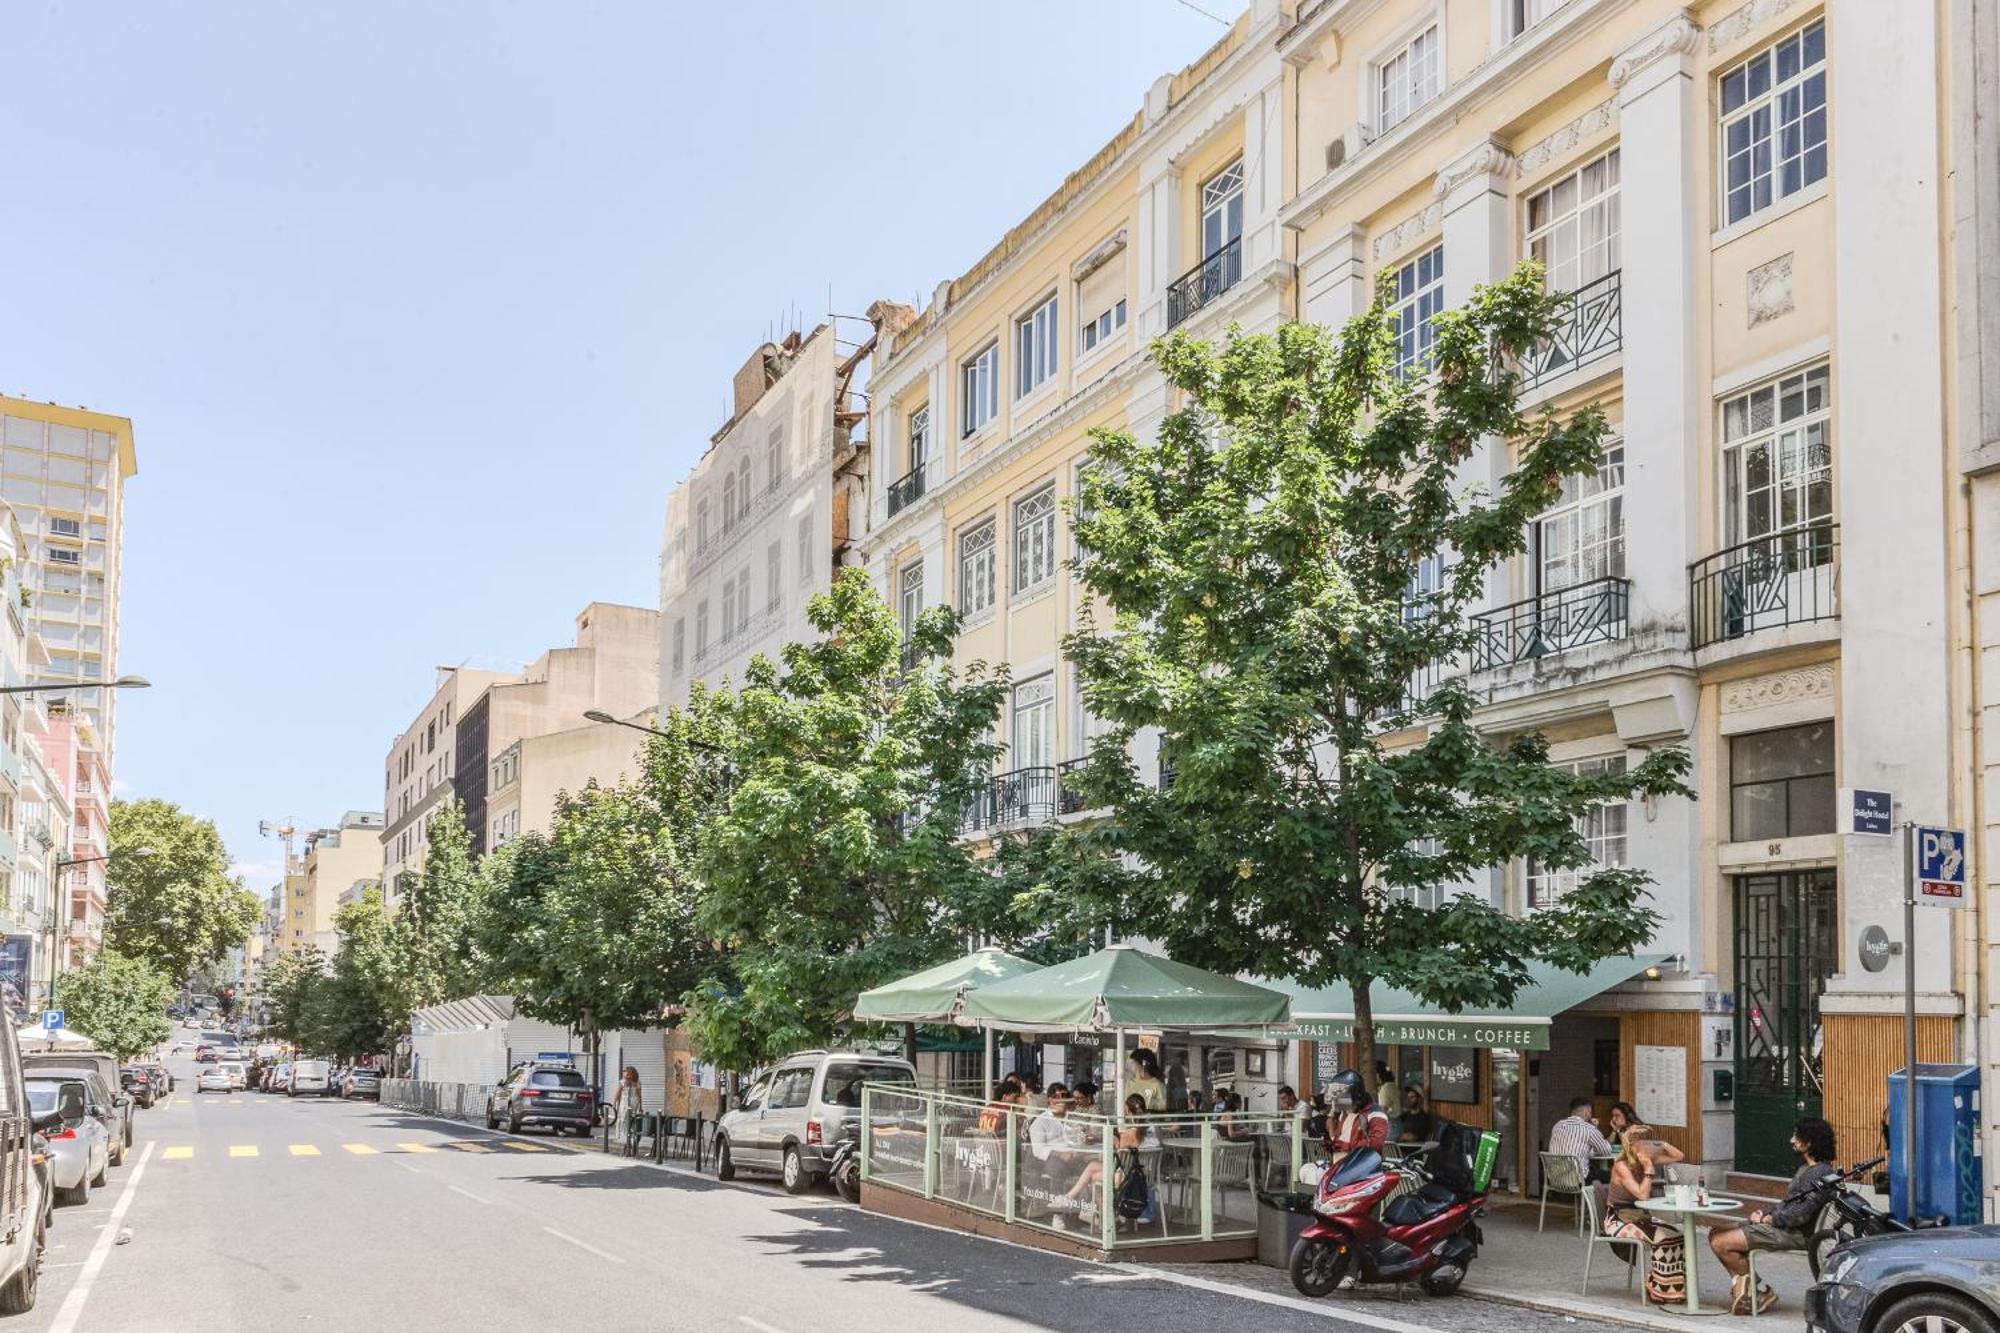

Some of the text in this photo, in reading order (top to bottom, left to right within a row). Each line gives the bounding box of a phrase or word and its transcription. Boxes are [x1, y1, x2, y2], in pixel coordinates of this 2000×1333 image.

[1866, 798, 1878, 807] The
[1768, 843, 1781, 856] 95
[1923, 832, 1940, 870] P
[47, 1012, 59, 1028] P
[1400, 1027, 1456, 1041] BRUNCH
[1474, 1029, 1531, 1044] COFFEE
[1433, 1060, 1472, 1084] hygge
[955, 1139, 991, 1172] hygge
